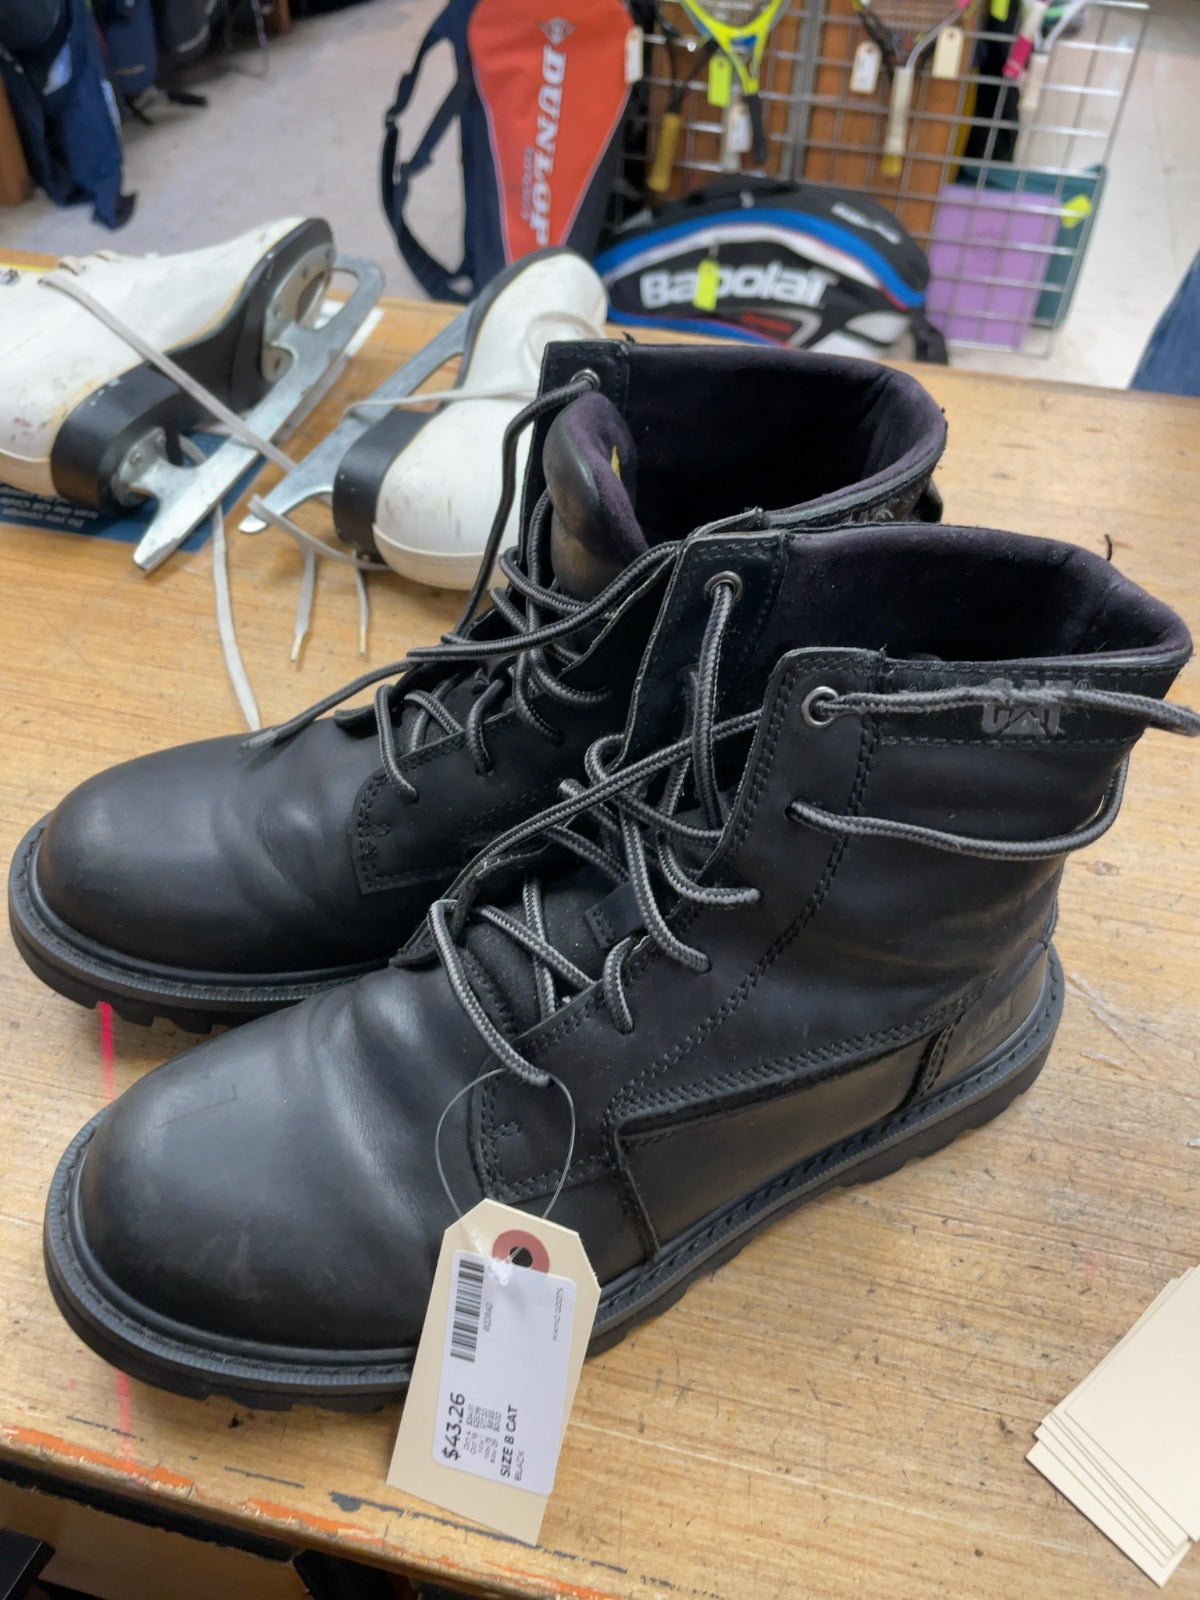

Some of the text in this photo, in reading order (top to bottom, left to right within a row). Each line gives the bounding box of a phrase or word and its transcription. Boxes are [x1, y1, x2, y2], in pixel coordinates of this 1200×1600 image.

[530, 44, 566, 247] DUNLOP
[441, 1392, 466, 1461] $43.26
[500, 1403, 519, 1477] SIZE 8 CAT
[514, 1450, 525, 1481] BLACK
